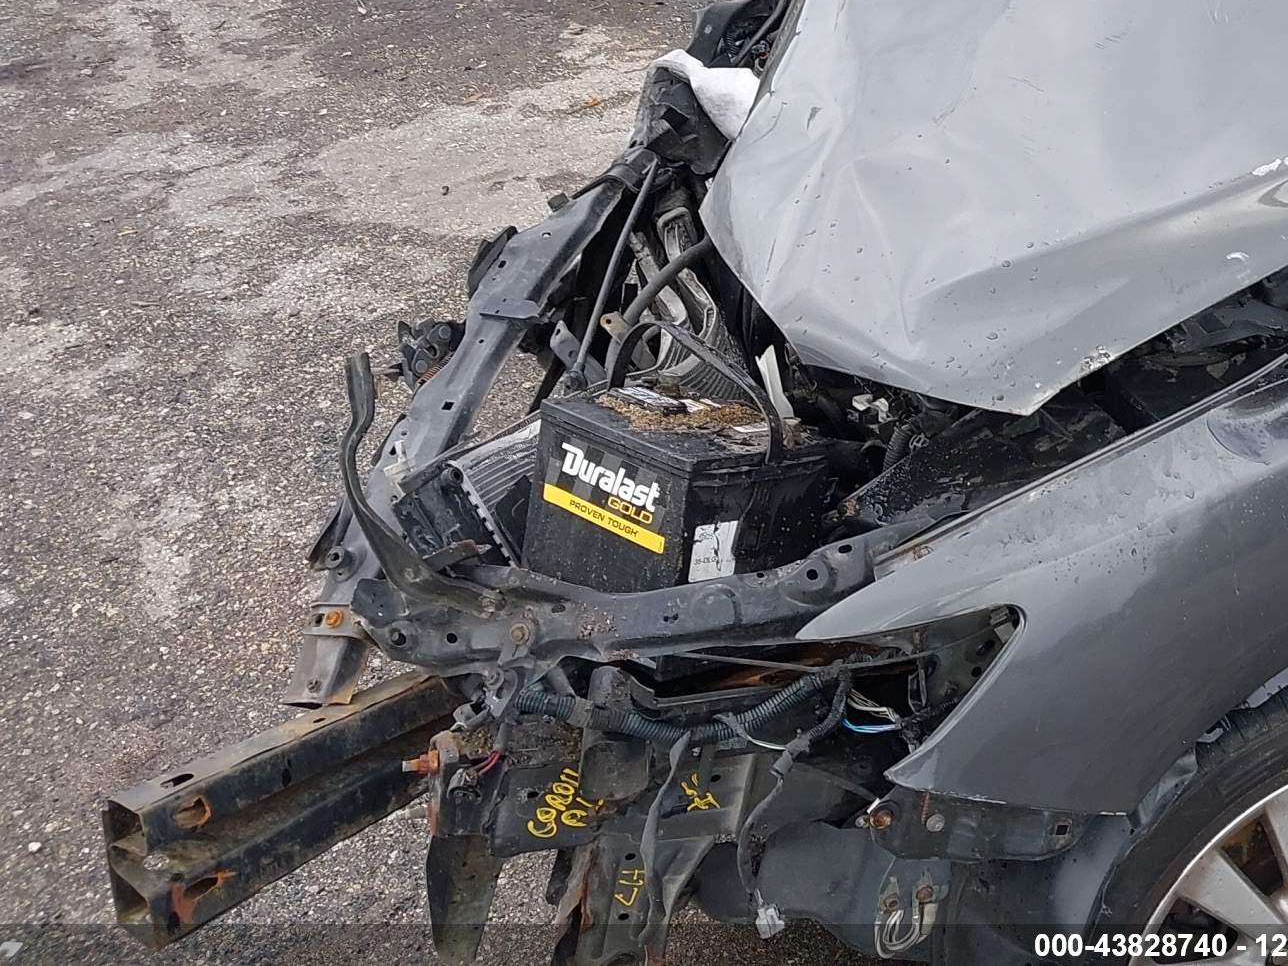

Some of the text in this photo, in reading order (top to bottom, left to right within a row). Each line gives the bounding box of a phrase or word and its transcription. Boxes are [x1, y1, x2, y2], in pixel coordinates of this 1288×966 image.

[561, 441, 661, 513] Duralast
[568, 498, 639, 538] PROVEN TOUGH
[607, 495, 653, 525] GOLD
